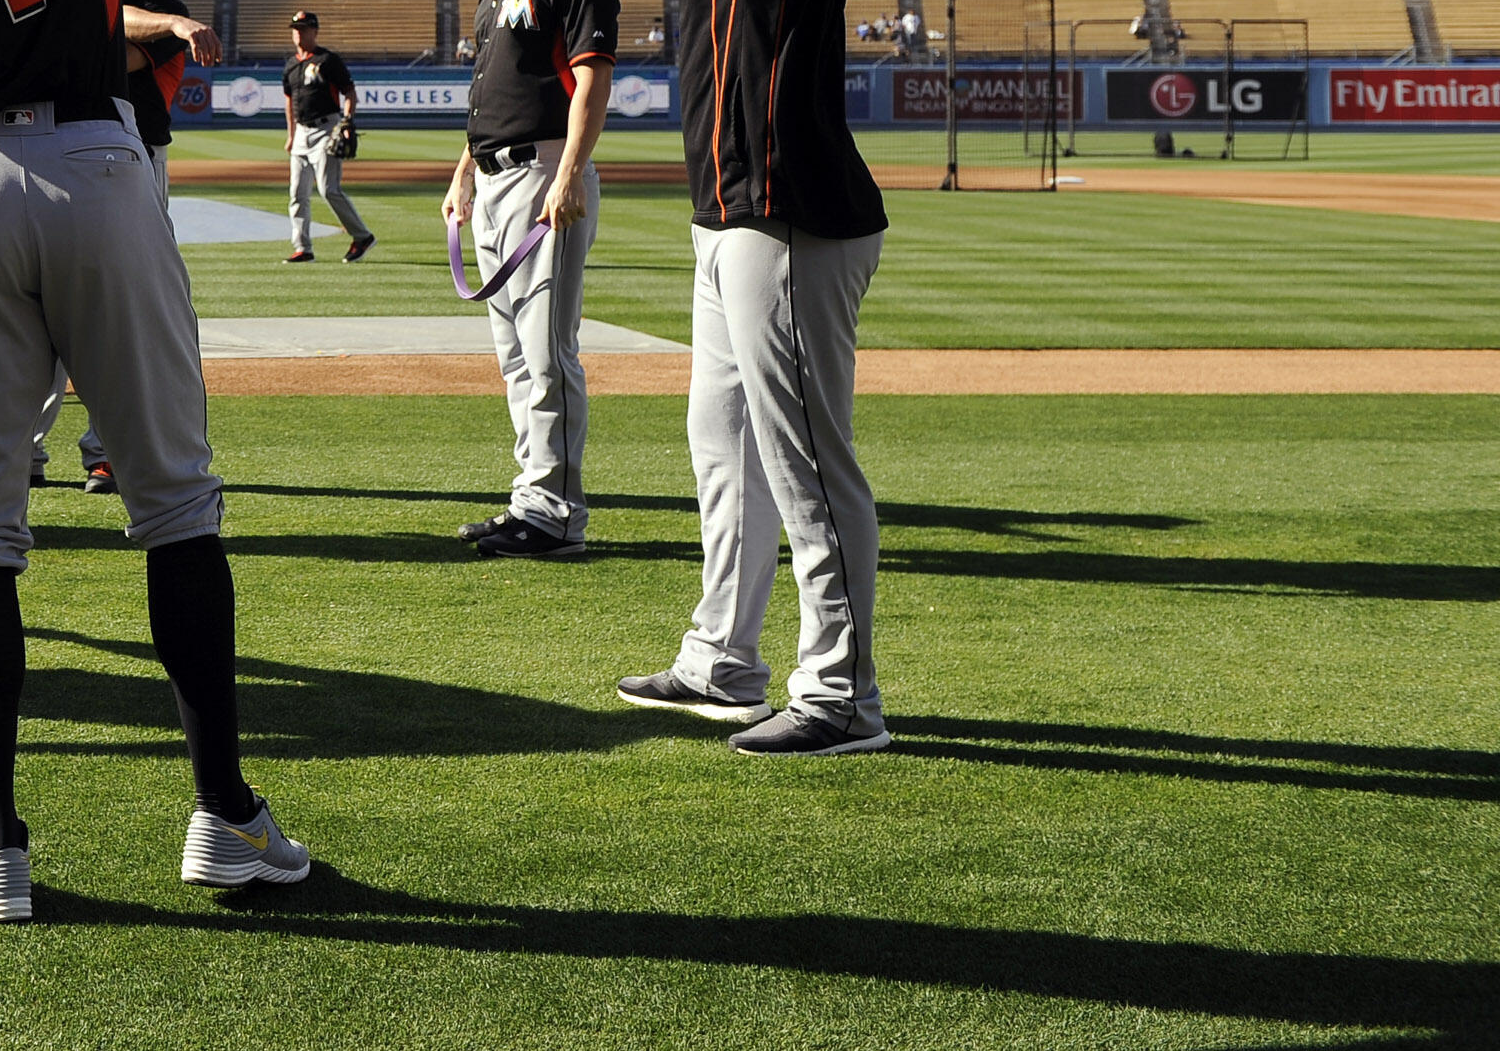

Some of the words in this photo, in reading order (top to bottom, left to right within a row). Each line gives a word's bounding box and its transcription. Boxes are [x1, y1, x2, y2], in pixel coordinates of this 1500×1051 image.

[180, 86, 205, 105] 76
[364, 89, 453, 104] NGELES
[903, 78, 949, 99] SAN
[1206, 79, 1263, 114] LG
[1335, 79, 1388, 114] Fly
[1394, 77, 1500, 108] Emirat
